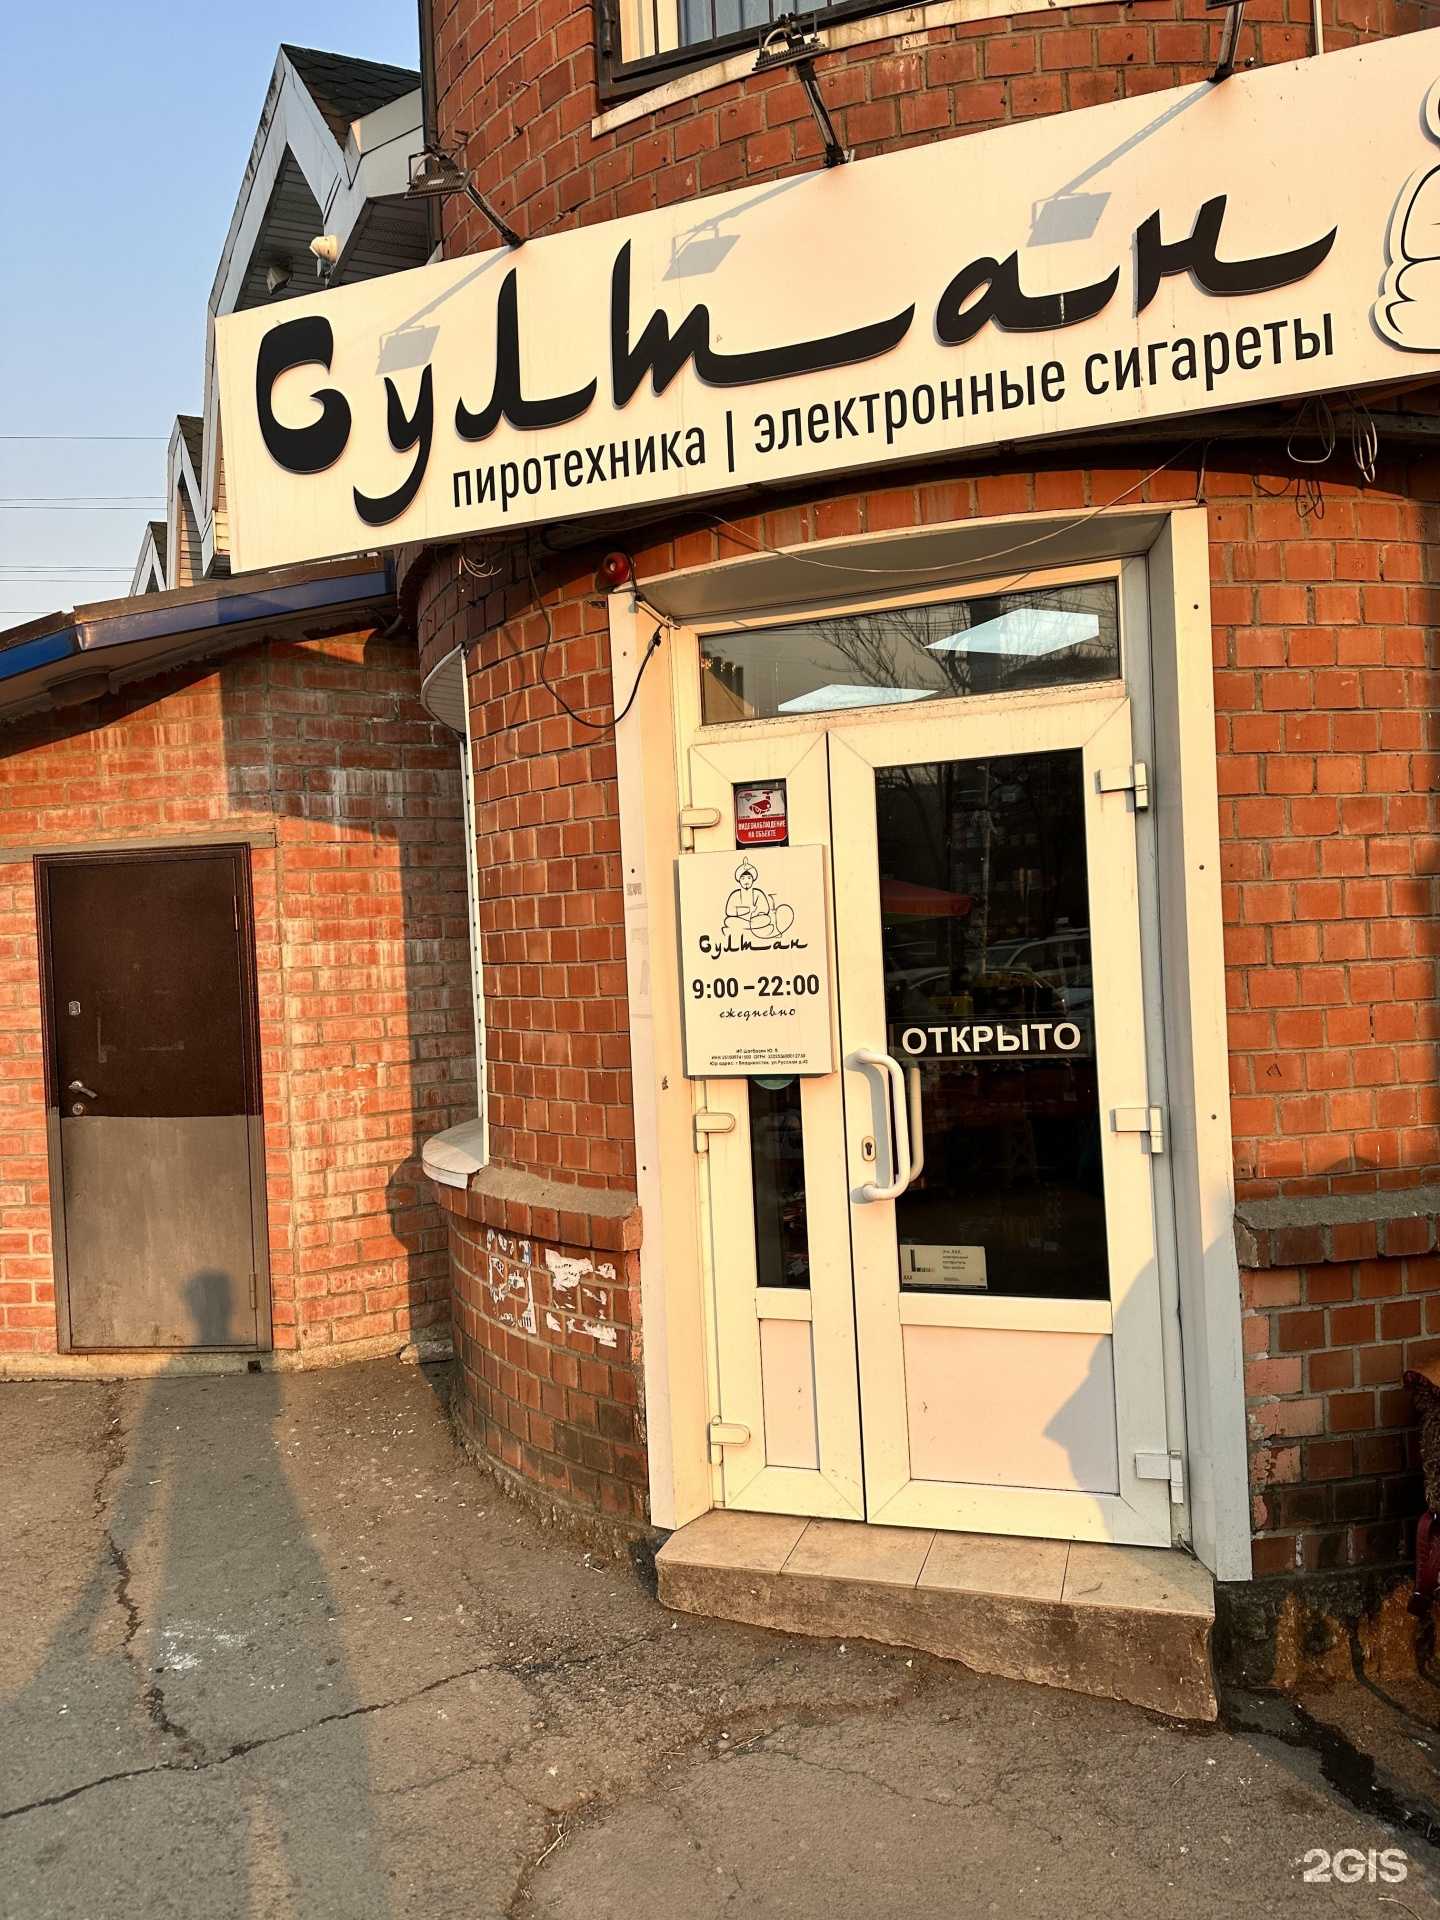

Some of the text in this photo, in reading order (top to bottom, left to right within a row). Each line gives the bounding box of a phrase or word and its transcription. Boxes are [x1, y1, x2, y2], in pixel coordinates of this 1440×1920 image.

[255, 193, 1338, 526] Султан
[453, 312, 1334, 512] пиротехника электронные сигареты
[699, 933, 808, 960] Султан
[719, 1005, 796, 1021] ежедневно
[901, 1021, 1082, 1056] ОТКРЫТО
